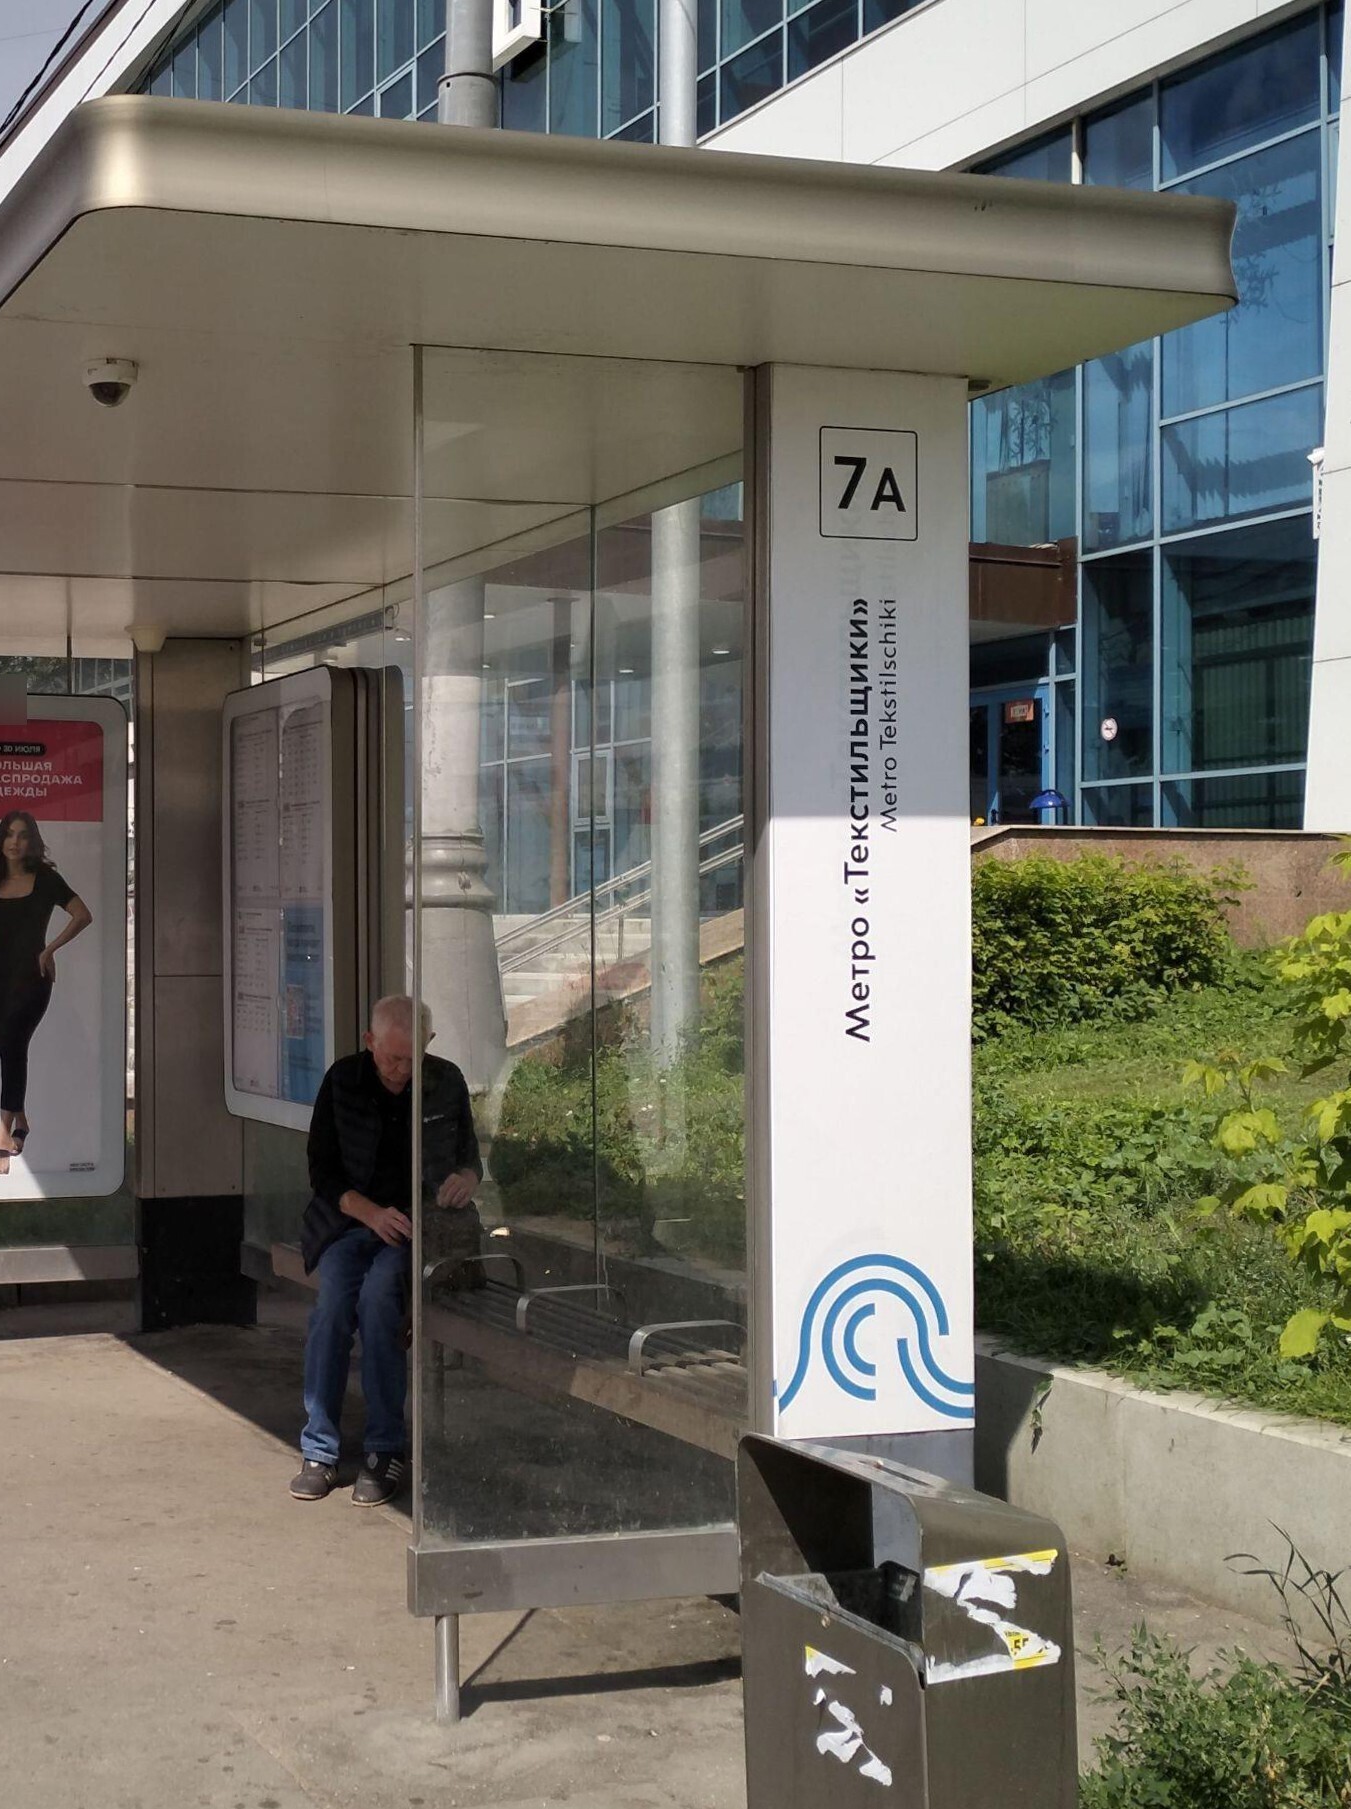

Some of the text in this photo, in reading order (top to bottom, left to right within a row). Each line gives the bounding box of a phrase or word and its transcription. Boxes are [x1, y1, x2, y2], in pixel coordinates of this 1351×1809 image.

[14, 745, 41, 754] ИЮЛЯ
[844, 597, 877, 1043] Метро «Текстильщики»
[879, 599, 897, 833] Metro Tekstilschiki
